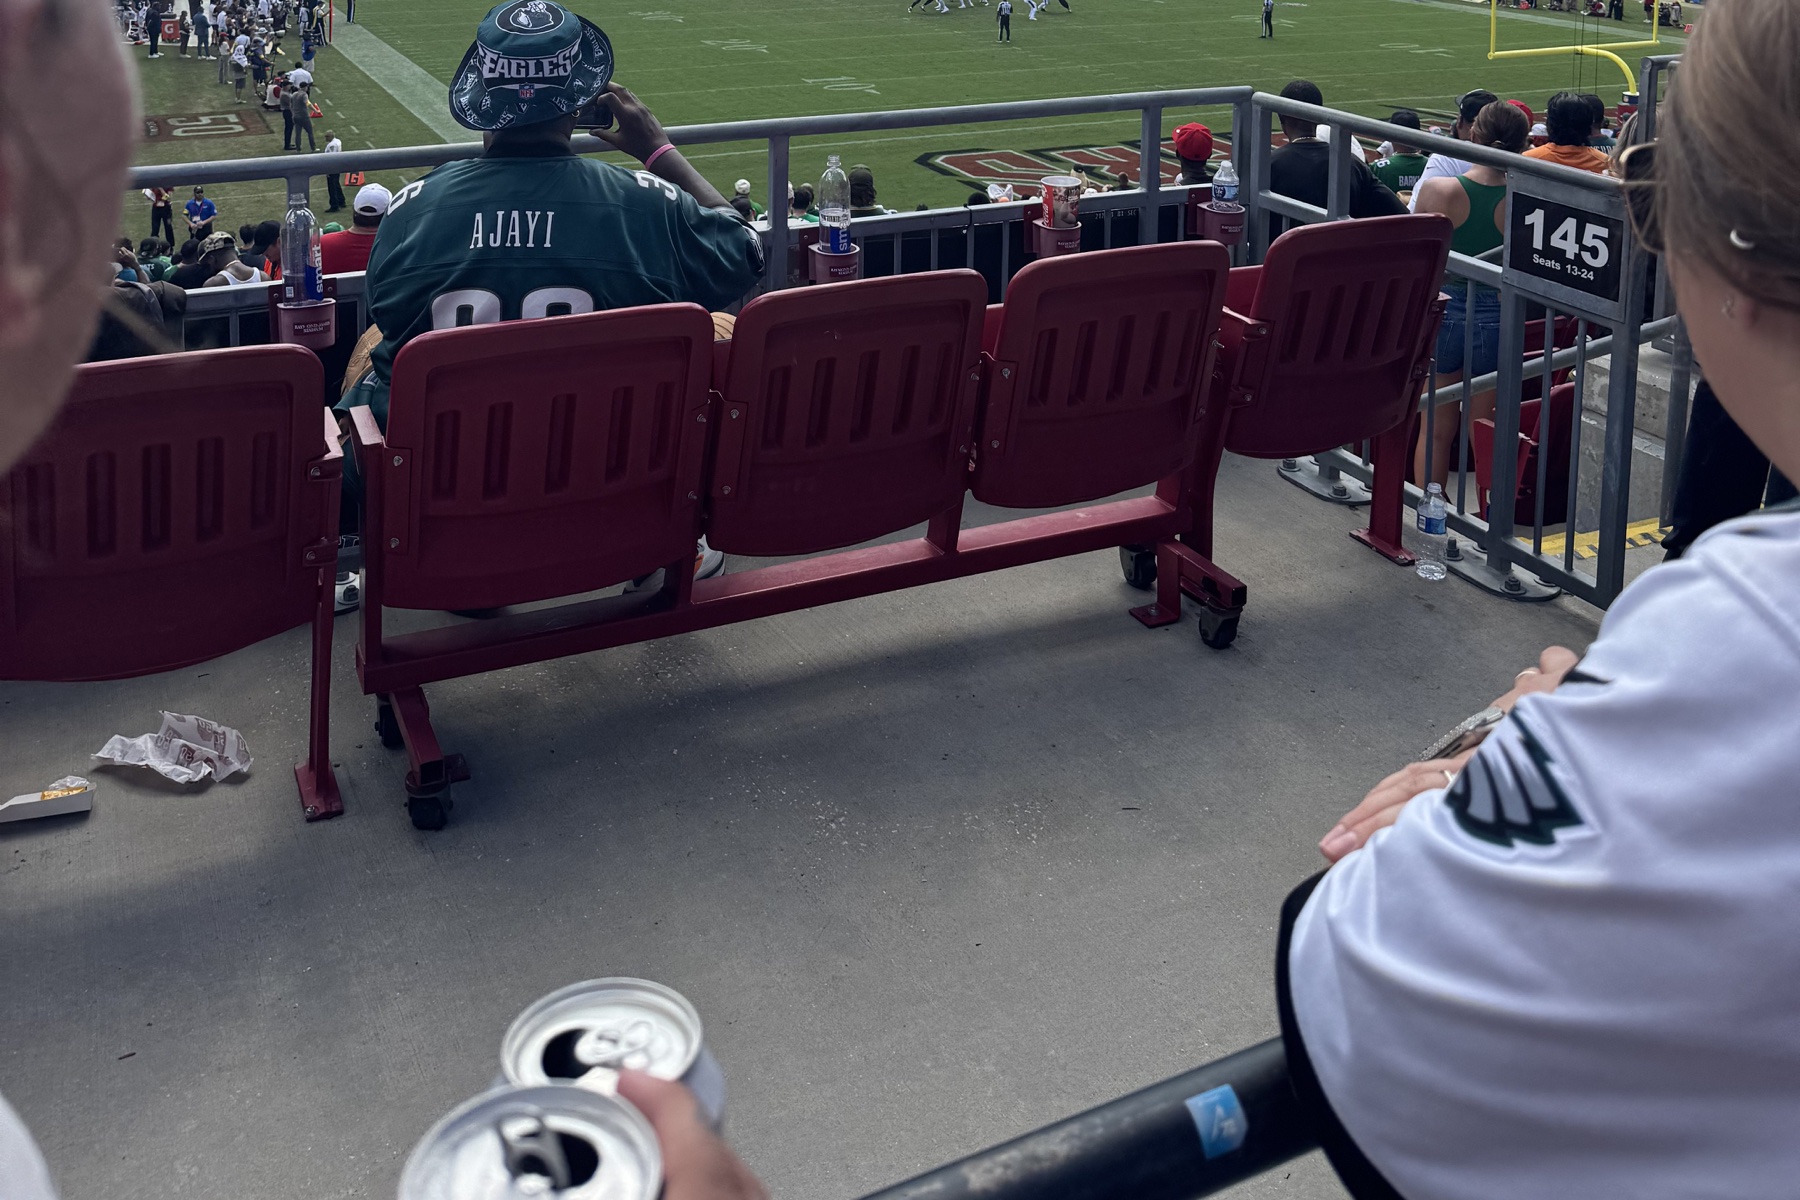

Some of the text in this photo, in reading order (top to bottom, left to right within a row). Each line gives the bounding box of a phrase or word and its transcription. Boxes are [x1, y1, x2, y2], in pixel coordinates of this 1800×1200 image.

[482, 50, 573, 79] EAGLES
[520, 90, 535, 98] NFL
[469, 210, 555, 249] AJAYI
[1524, 208, 1609, 268] 145
[1532, 253, 1595, 280] Seats 13-24
